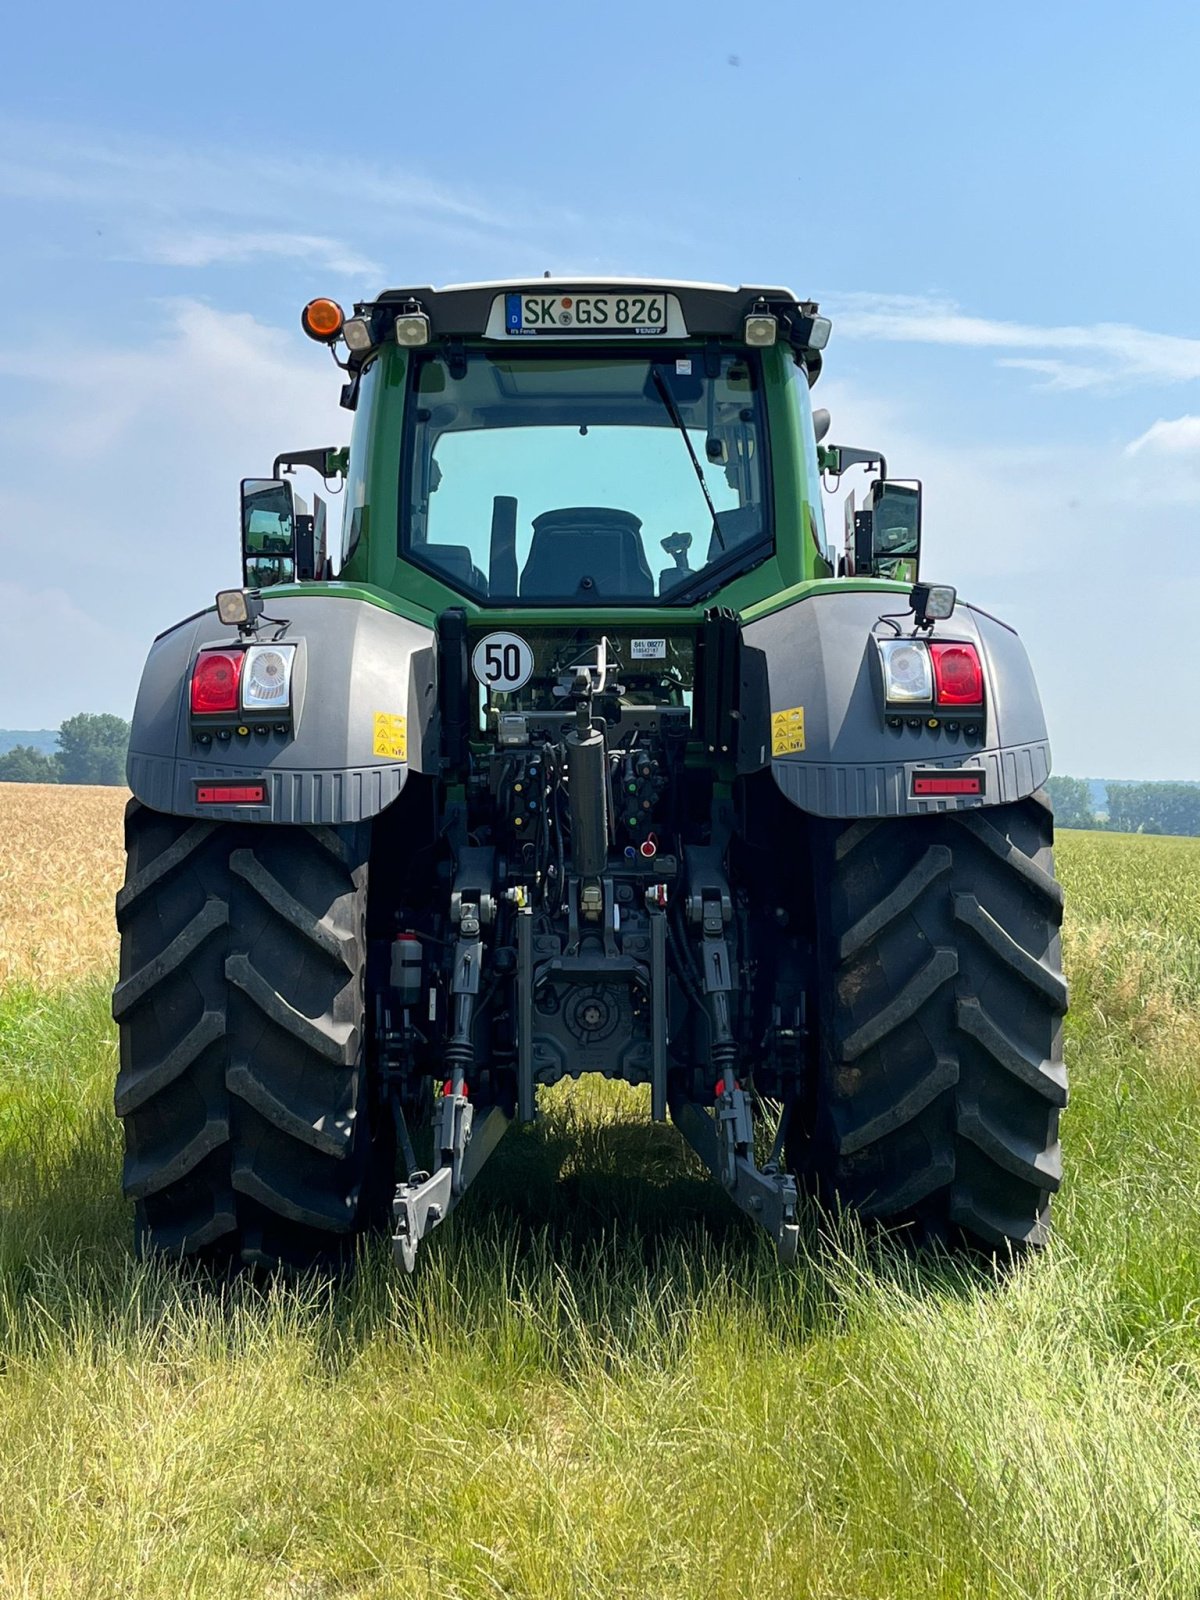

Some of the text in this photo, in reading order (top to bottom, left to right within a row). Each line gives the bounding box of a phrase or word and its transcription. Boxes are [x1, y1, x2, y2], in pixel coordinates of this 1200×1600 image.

[511, 315, 518, 324] D
[524, 299, 662, 324] SK GS 826
[485, 643, 520, 681] 50
